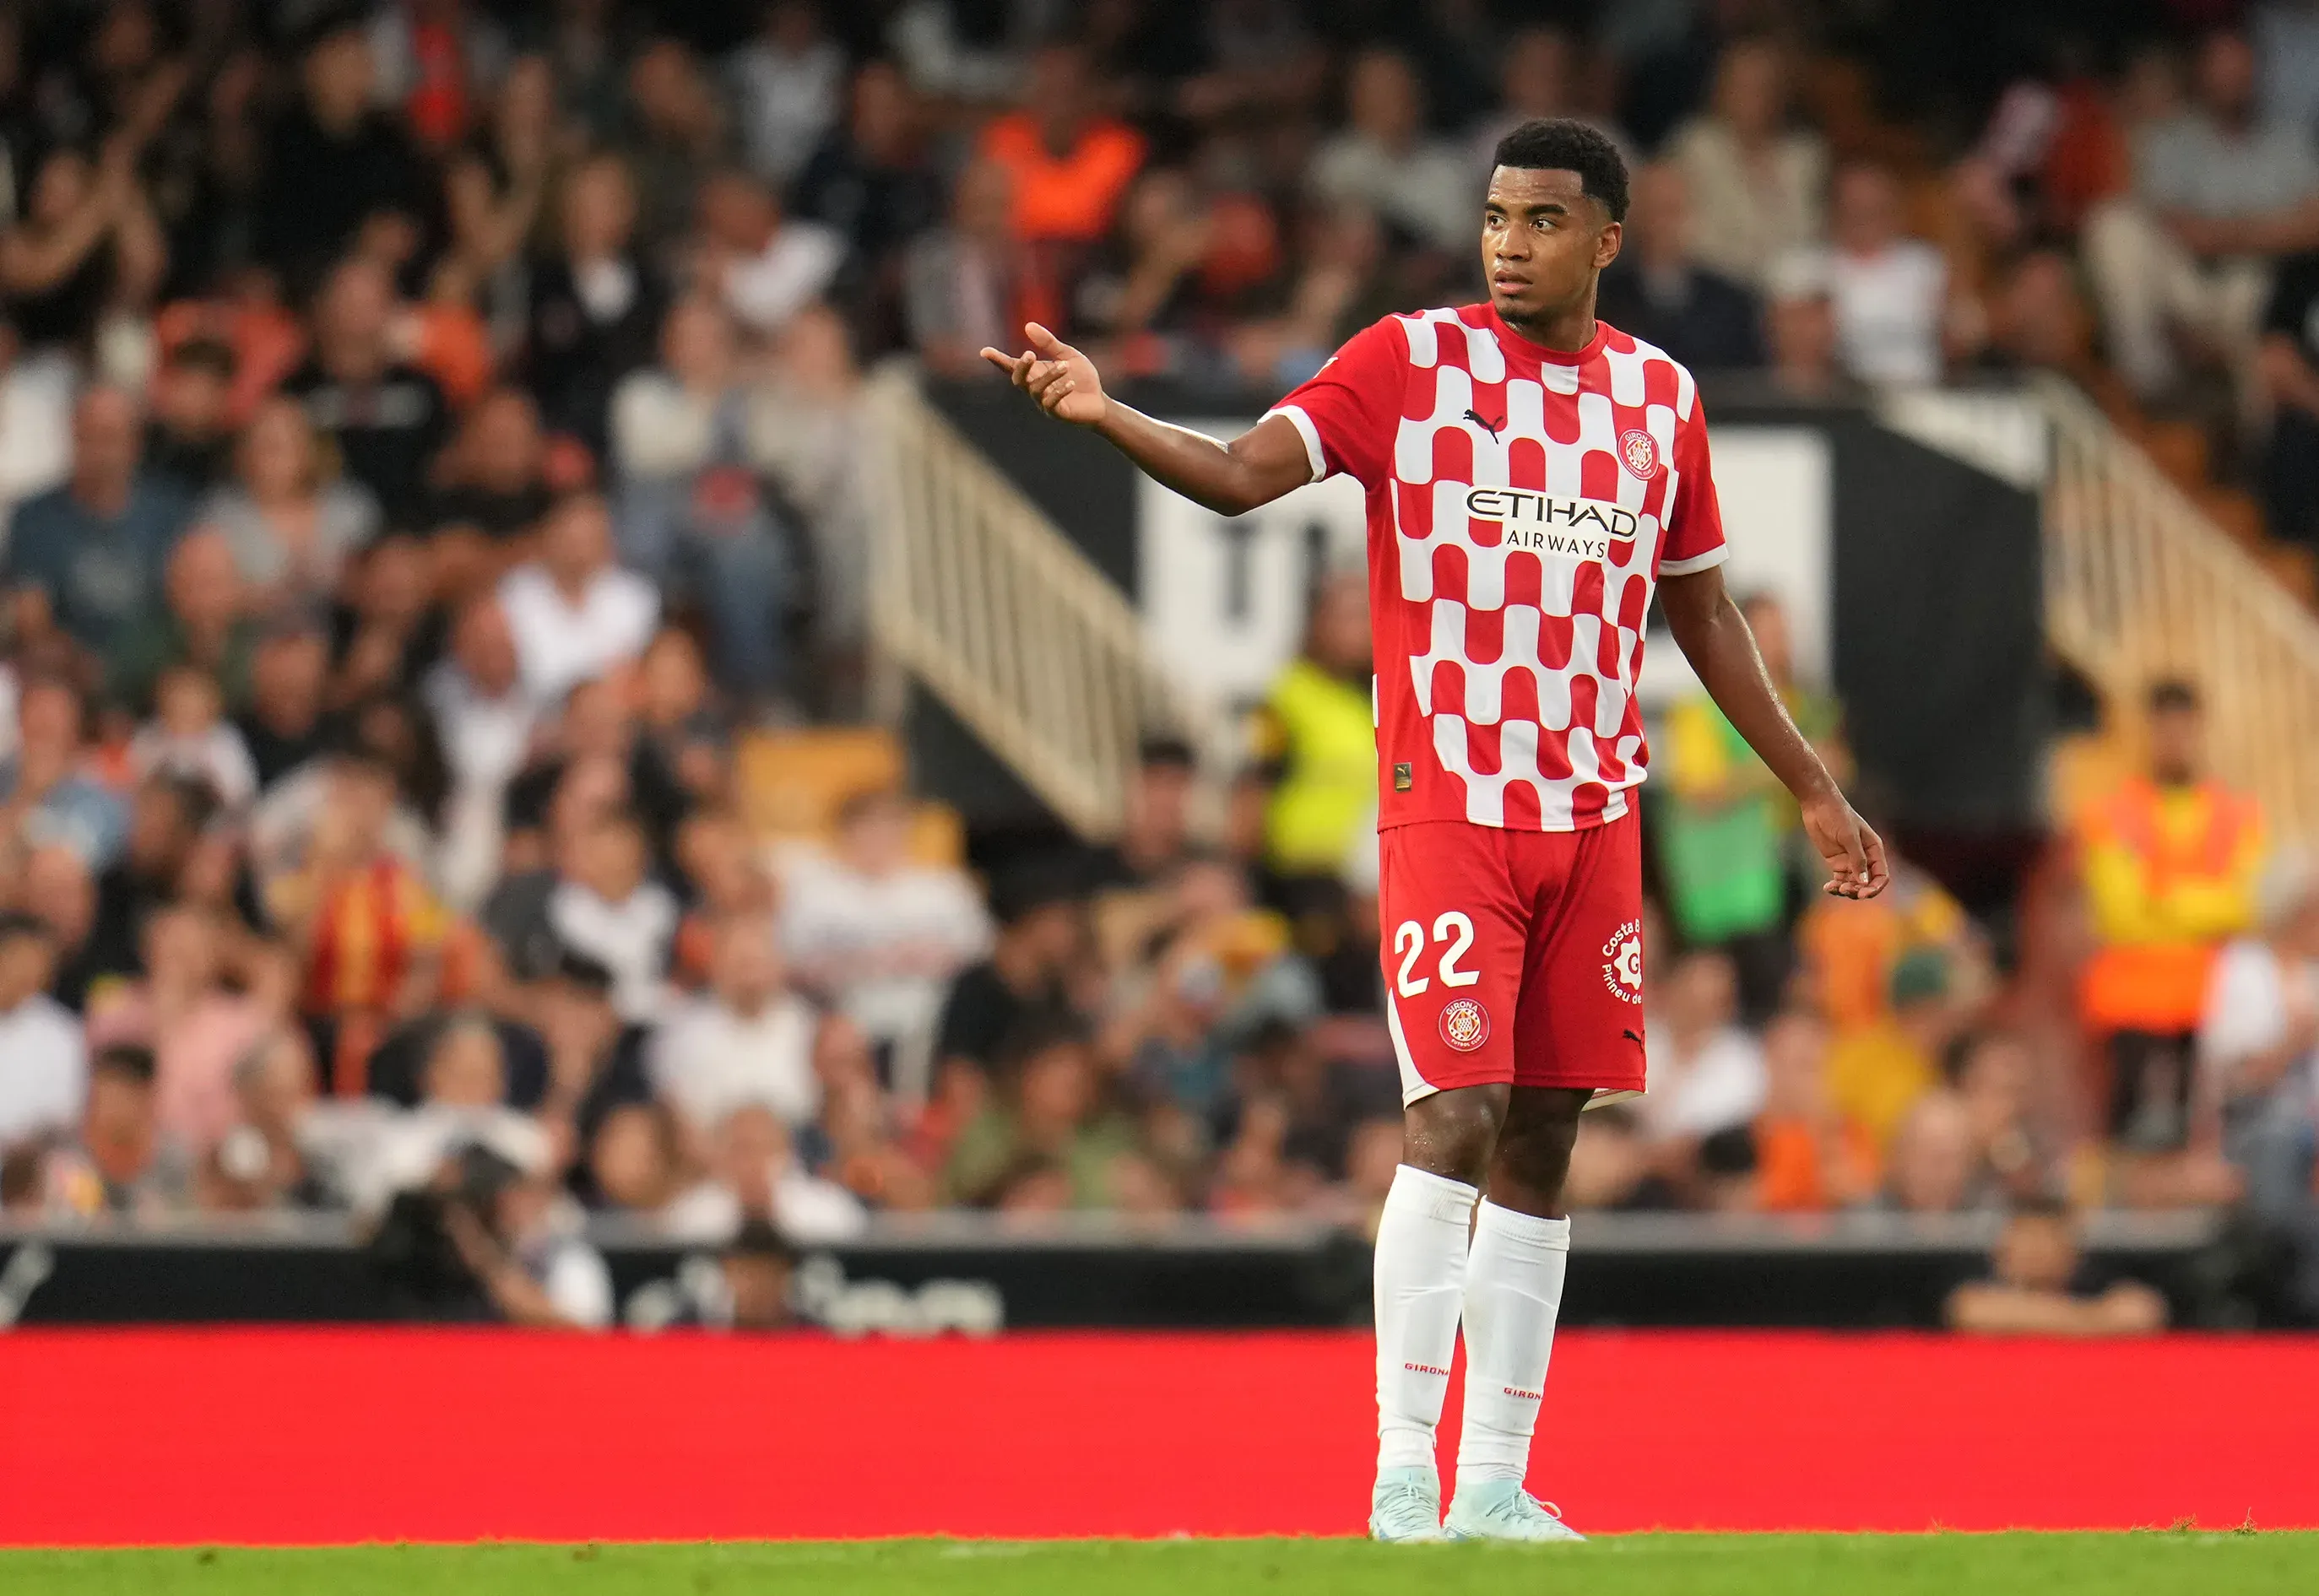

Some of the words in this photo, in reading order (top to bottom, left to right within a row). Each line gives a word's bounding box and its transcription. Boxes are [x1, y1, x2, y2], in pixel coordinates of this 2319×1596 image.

[1625, 432, 1652, 446] GIRONA
[1466, 490, 1637, 538] ETIHAD
[1506, 529, 1606, 558] AIRWAYS
[1394, 911, 1480, 998] 22
[1601, 922, 1634, 957] Costa
[1601, 963, 1631, 1003] Pirineu
[1445, 1001, 1478, 1015] GIRONA
[1504, 1387, 1543, 1401] GIRON
